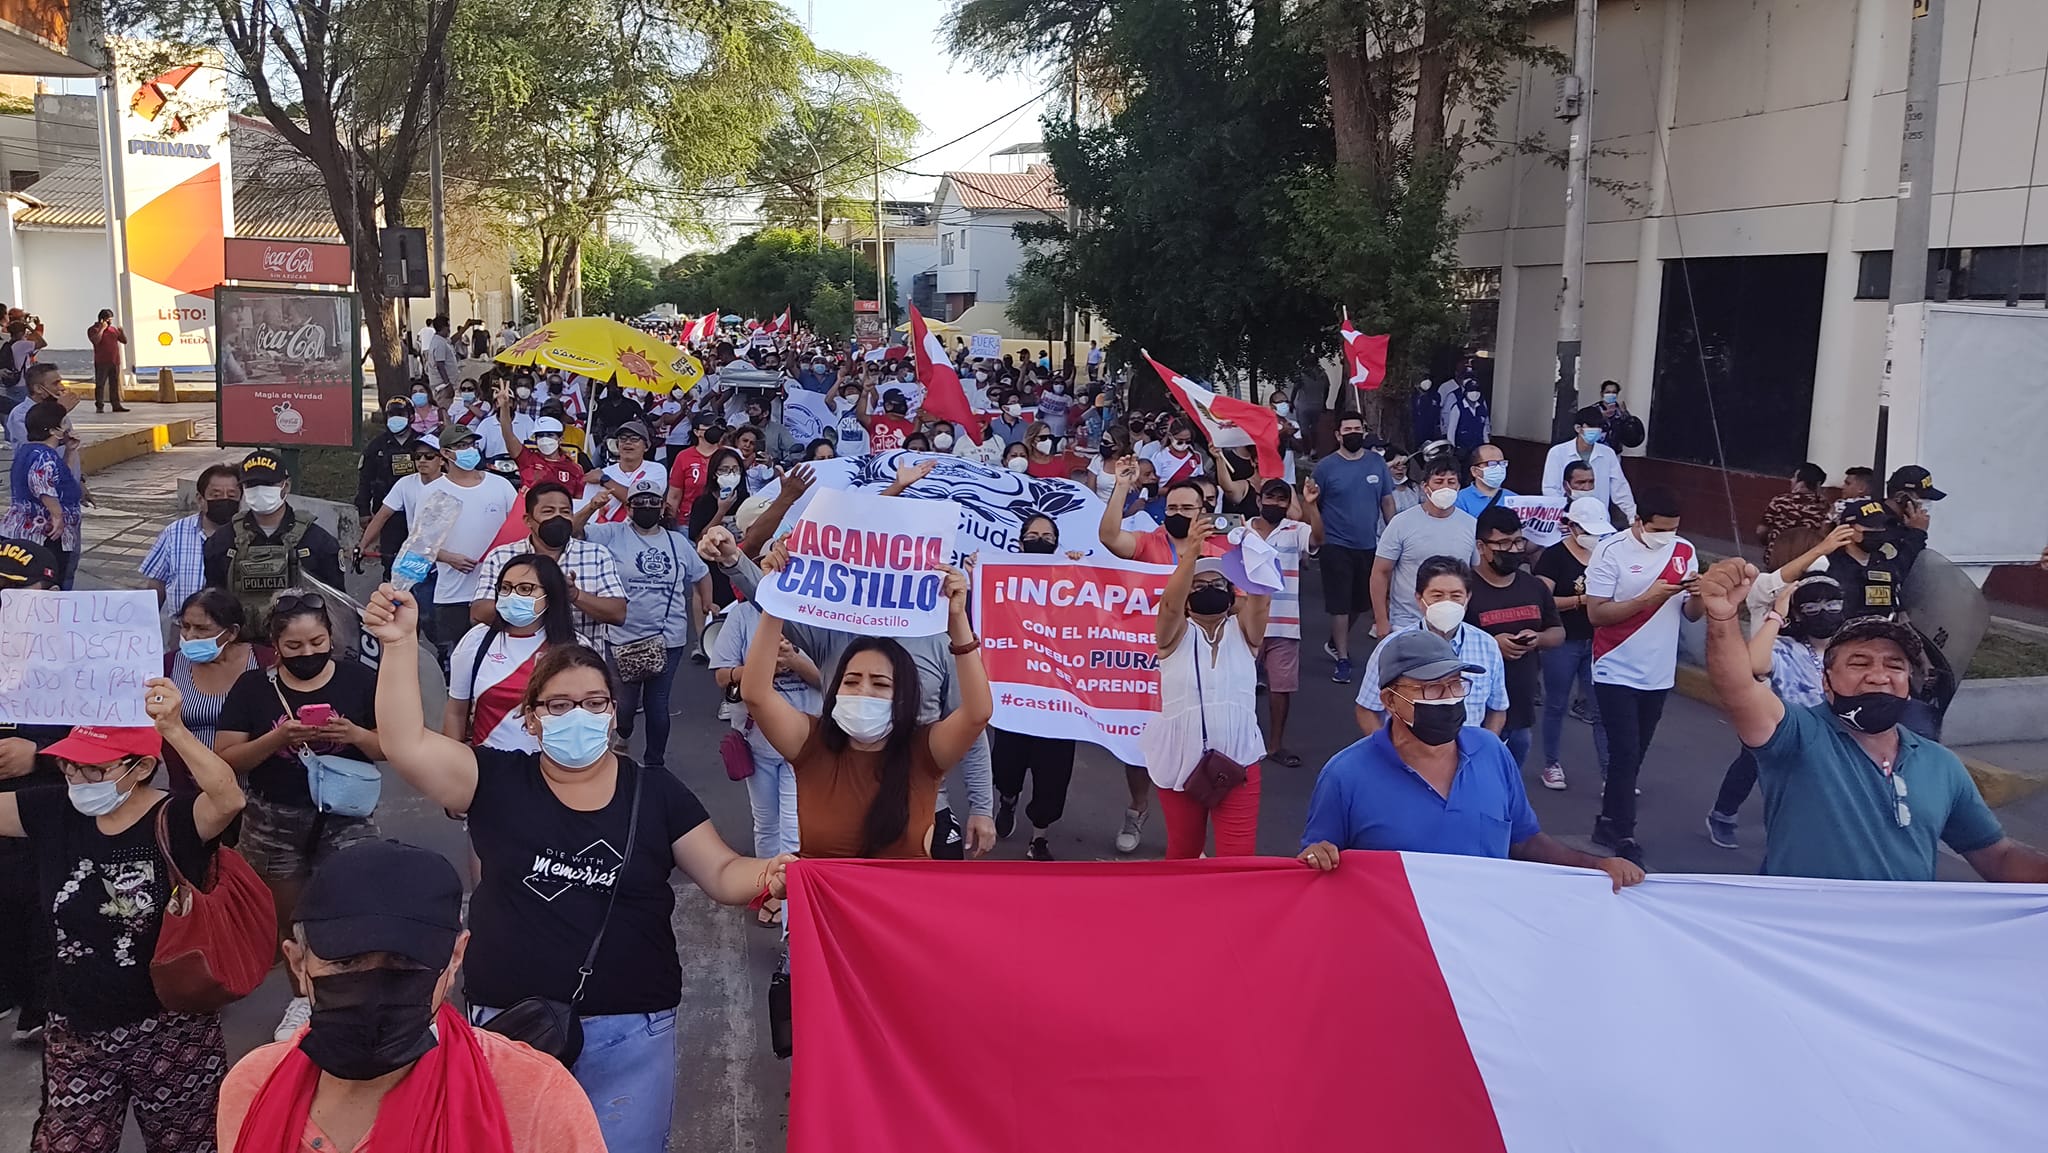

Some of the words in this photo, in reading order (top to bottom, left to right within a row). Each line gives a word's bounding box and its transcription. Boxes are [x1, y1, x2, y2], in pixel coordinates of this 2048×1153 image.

[127, 139, 212, 159] PRIMAX
[263, 246, 314, 273] Coca-Cola
[255, 321, 326, 360] Coca-Cola
[254, 391, 280, 399] Magia
[293, 392, 323, 400] Verdad
[243, 456, 277, 472] POLICIA
[692, 468, 700, 484] 9
[784, 519, 942, 571] VACANCIA
[244, 577, 286, 589] POLICIA
[776, 556, 941, 612] CASTILLO
[798, 603, 909, 628] #VacanciaCastillo
[1022, 619, 1056, 639] CON
[1062, 626, 1082, 639] EL
[1087, 626, 1158, 645] HAMBRE
[984, 637, 1018, 649] DEL
[1023, 640, 1085, 668] PUEBLO
[1090, 649, 1162, 671] PIURA
[1026, 659, 1051, 674] NO
[1055, 667, 1073, 685] SE
[1076, 679, 1159, 695] APRENDE
[546, 848, 566, 859] DIE
[571, 855, 604, 865] WITH
[532, 855, 617, 887] Memories
